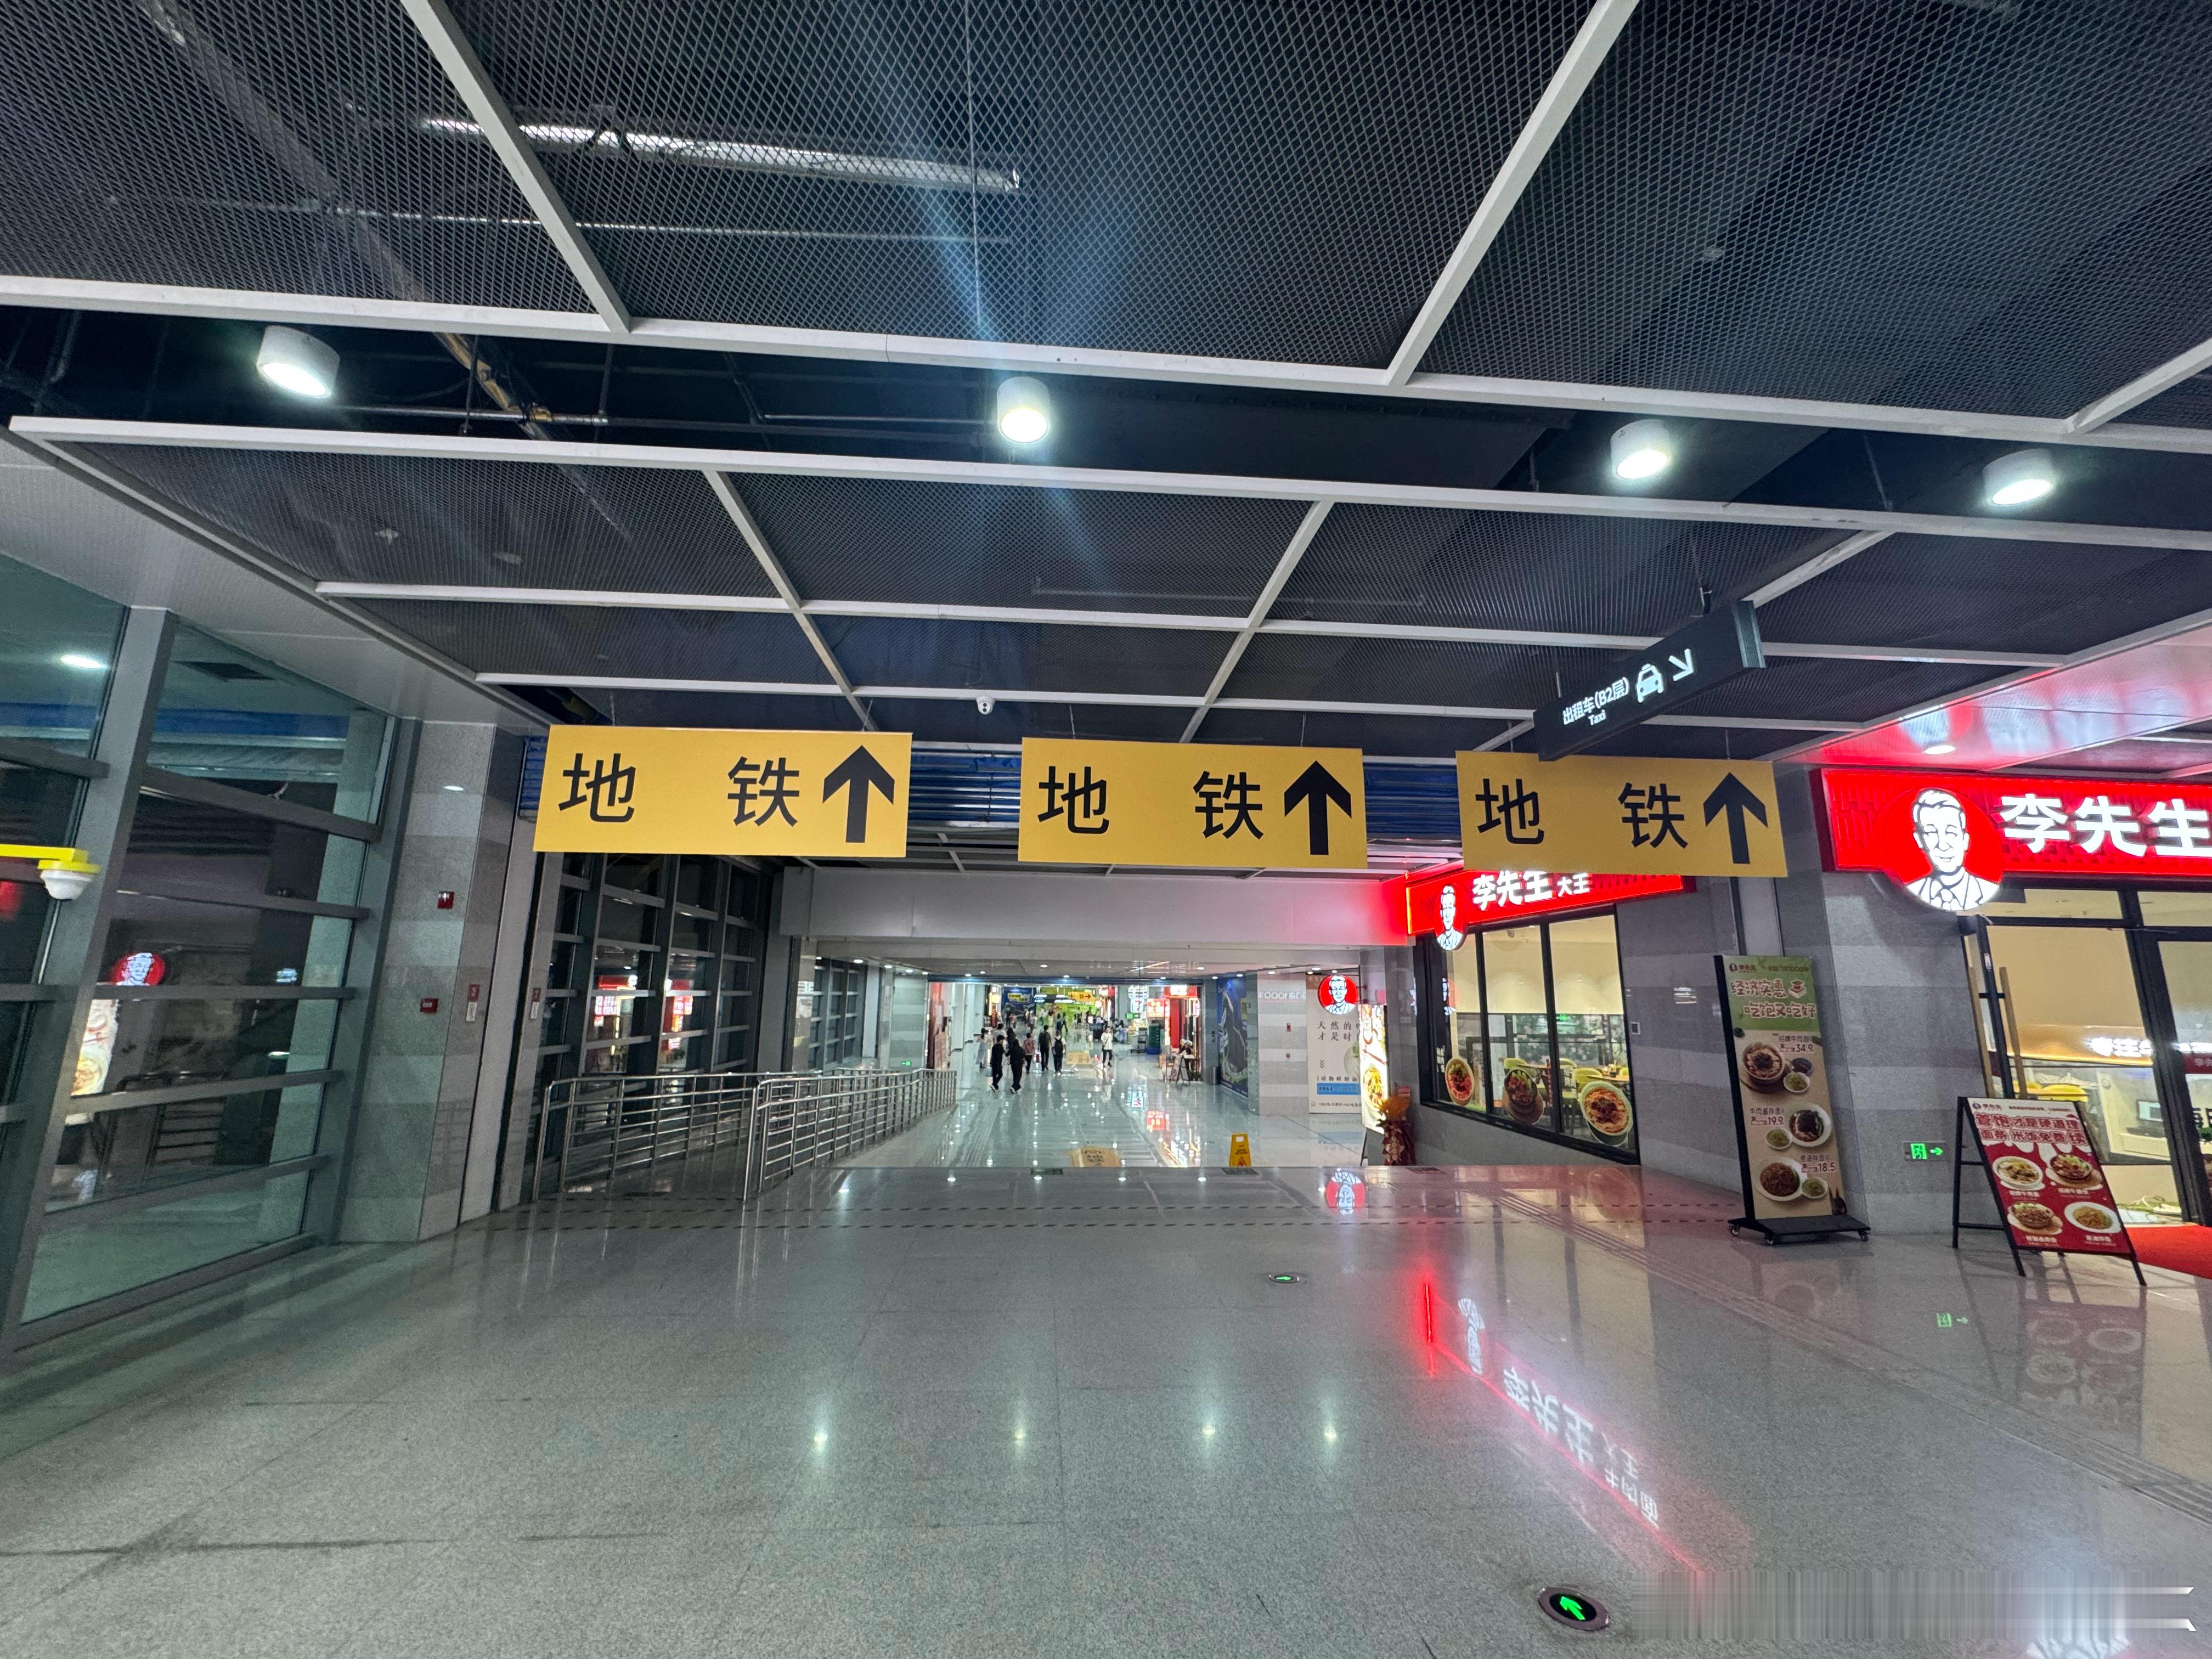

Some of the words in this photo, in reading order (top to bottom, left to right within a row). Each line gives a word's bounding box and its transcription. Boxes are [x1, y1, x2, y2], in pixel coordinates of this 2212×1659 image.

[1563, 677, 1629, 725] 出租车(B2层)
[1588, 709, 1606, 725] Taxi
[558, 753, 800, 827] 地铁
[1038, 766, 1264, 839] 地铁
[1475, 778, 1688, 849] 地铁
[2000, 793, 2212, 857] 李先生
[1730, 979, 1788, 998] 经济实惠
[1744, 1001, 1816, 1019] 吃饱又吃好
[1818, 1163, 1835, 1172] 18.5
